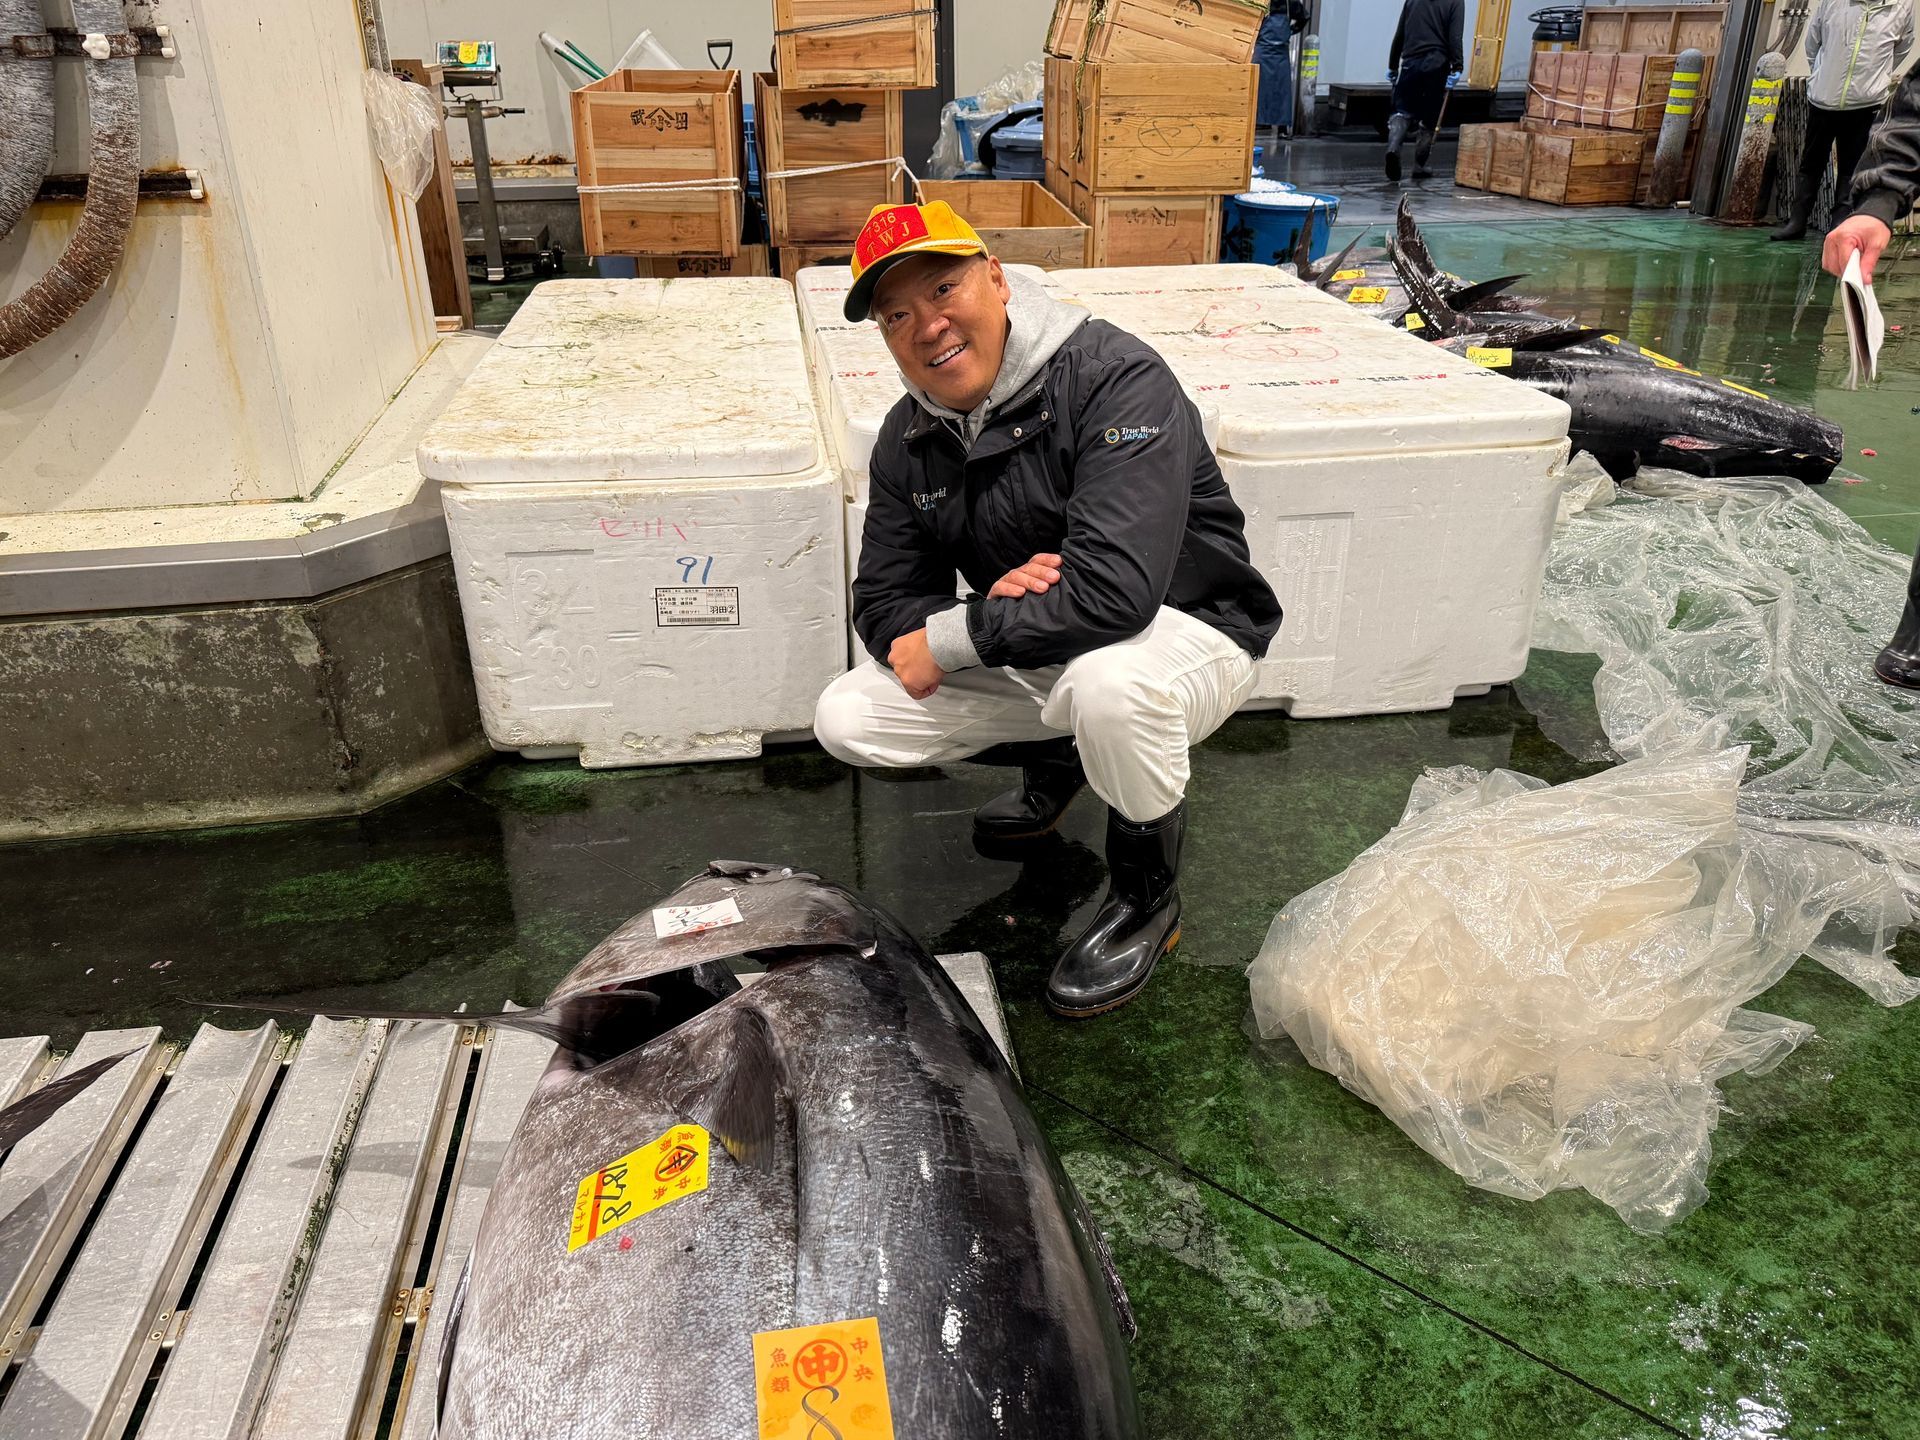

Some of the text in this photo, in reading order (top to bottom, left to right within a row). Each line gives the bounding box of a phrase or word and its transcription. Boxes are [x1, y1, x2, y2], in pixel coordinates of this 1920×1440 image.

[866, 212, 897, 238] 7316
[1121, 426, 1159, 435] True World
[676, 555, 714, 585] 91
[769, 1347, 791, 1394] 魚類
[850, 1336, 875, 1383] 中央
